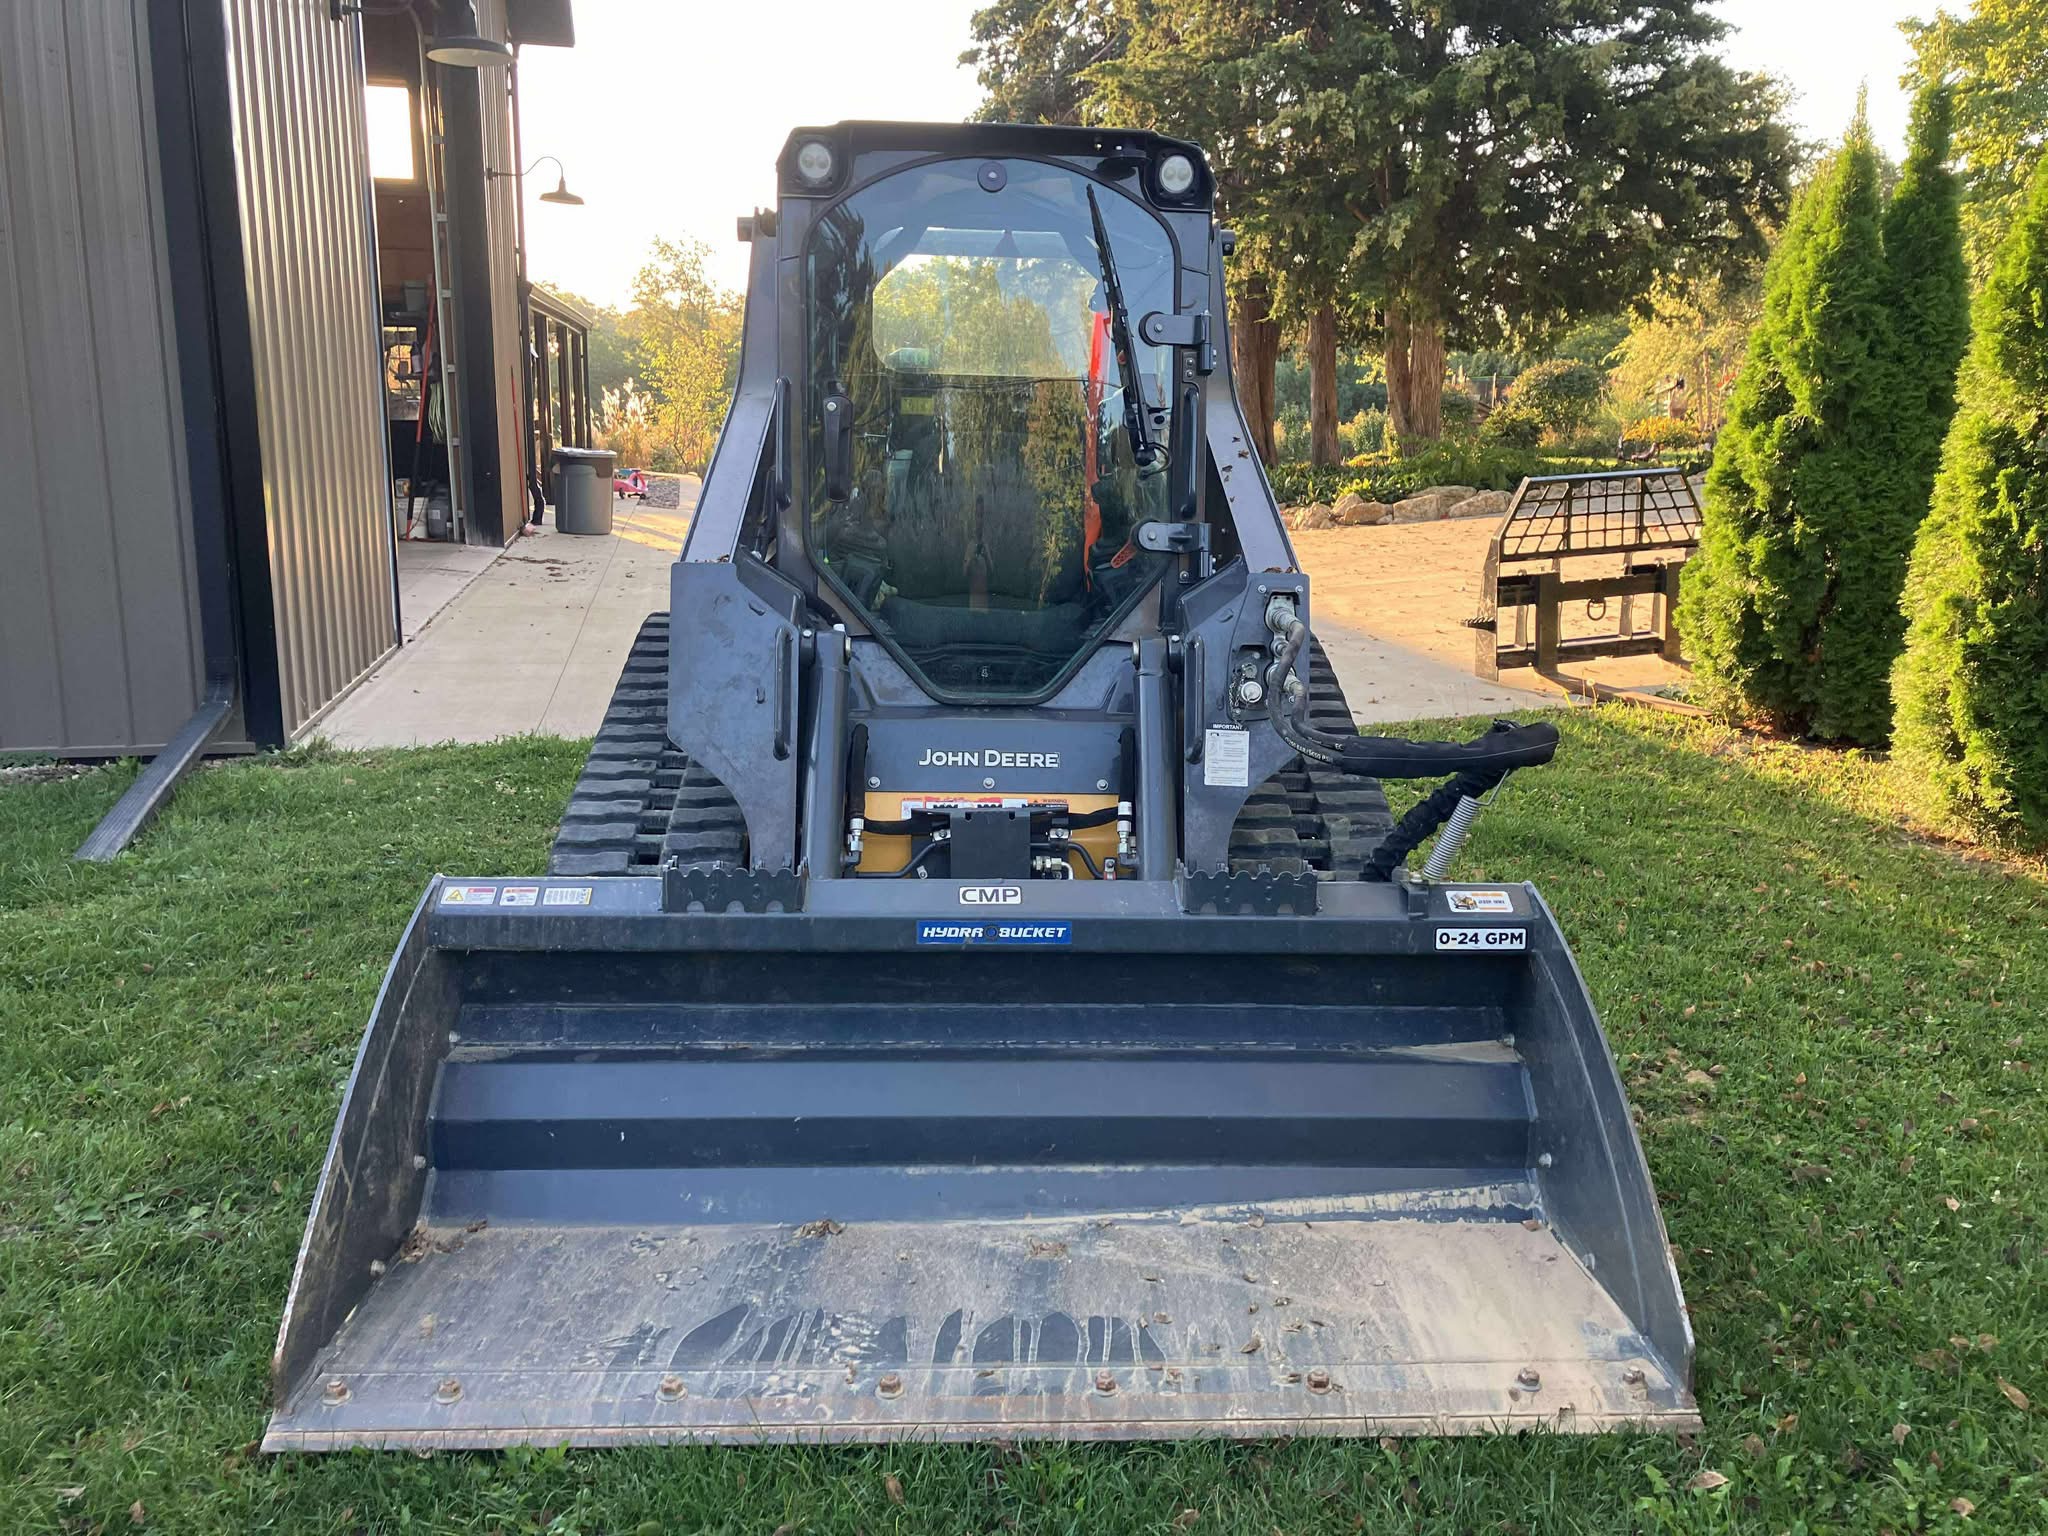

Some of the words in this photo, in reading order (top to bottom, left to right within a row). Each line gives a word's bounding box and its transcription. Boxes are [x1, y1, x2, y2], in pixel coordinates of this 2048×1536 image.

[919, 748, 979, 767] JOHN
[984, 749, 1060, 768] DEERE
[961, 888, 1019, 903] CMP
[922, 926, 984, 938] HYDRA
[998, 926, 1067, 938] BUCKET
[1439, 932, 1480, 945] 0-24
[1485, 932, 1524, 945] GPM
